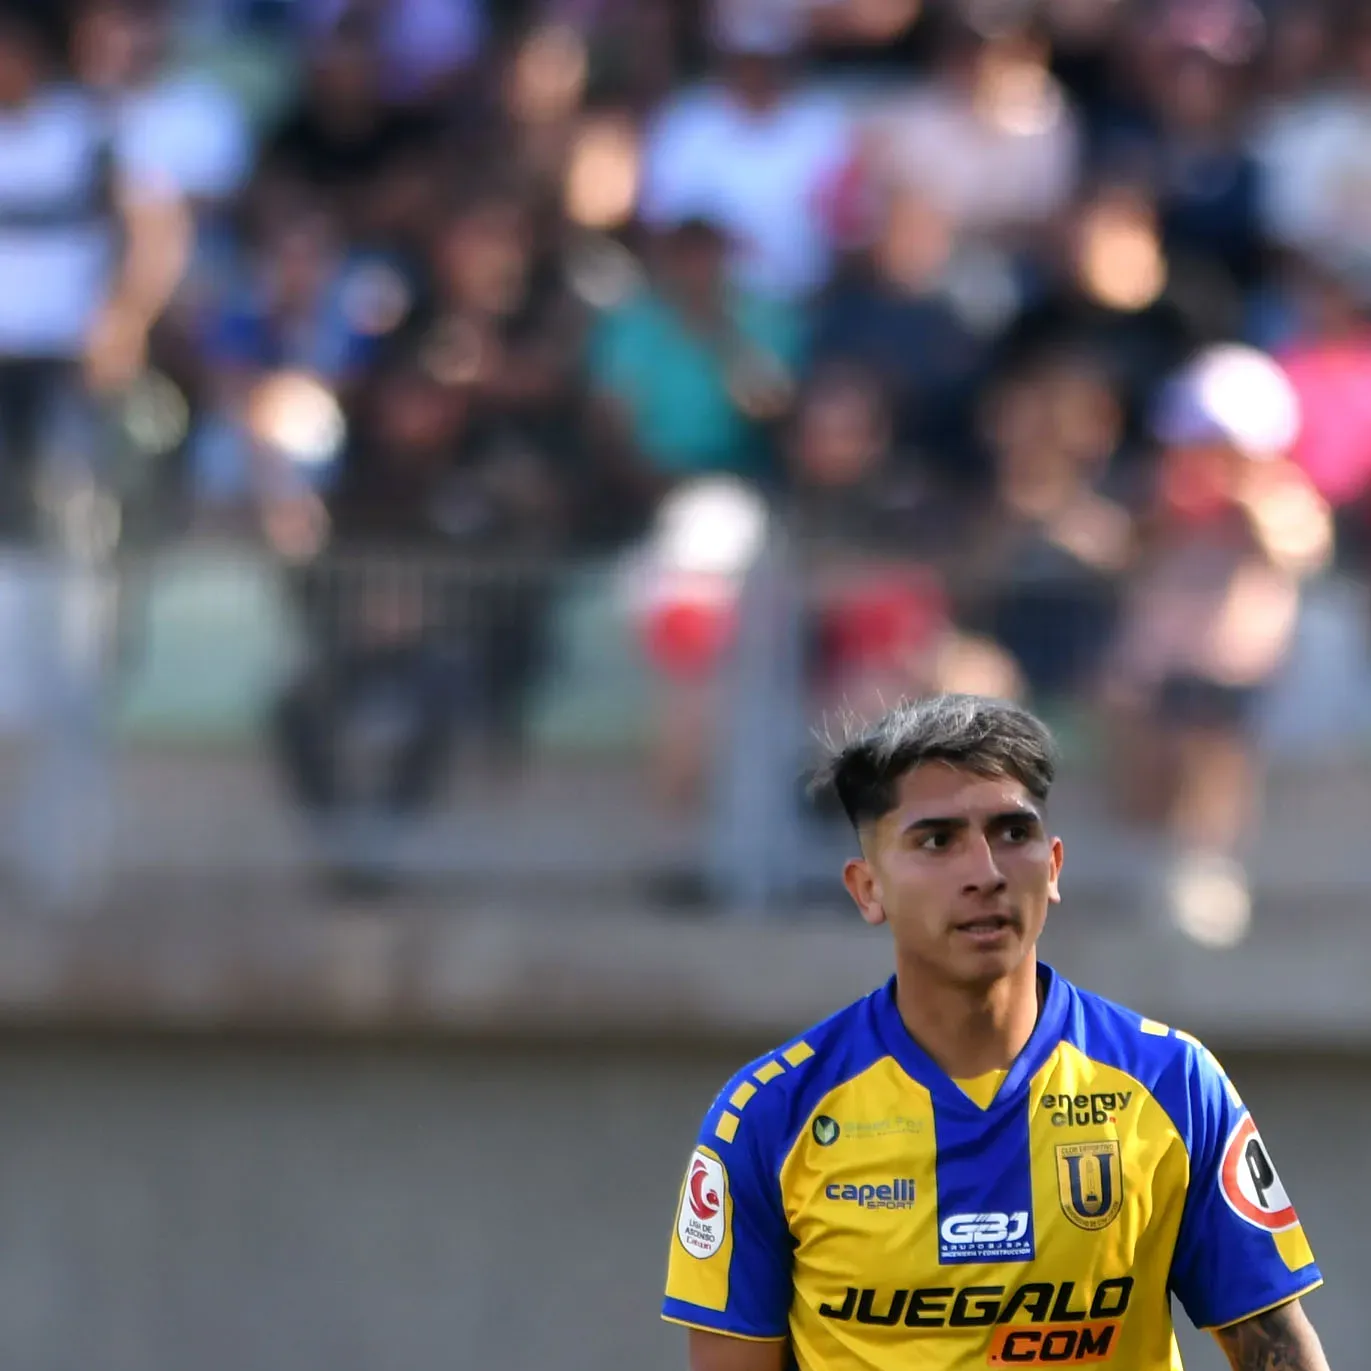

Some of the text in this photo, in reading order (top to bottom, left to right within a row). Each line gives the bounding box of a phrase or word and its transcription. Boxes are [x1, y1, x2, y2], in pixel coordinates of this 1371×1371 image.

[1041, 1091, 1132, 1111] energy
[825, 1178, 915, 1206] capelli
[1062, 1153, 1114, 1217] U
[866, 1201, 914, 1210] SPORT
[685, 1227, 716, 1243] ASCENSO
[819, 1276, 1134, 1327] JUEGALO
[991, 1326, 1115, 1363] .COM
